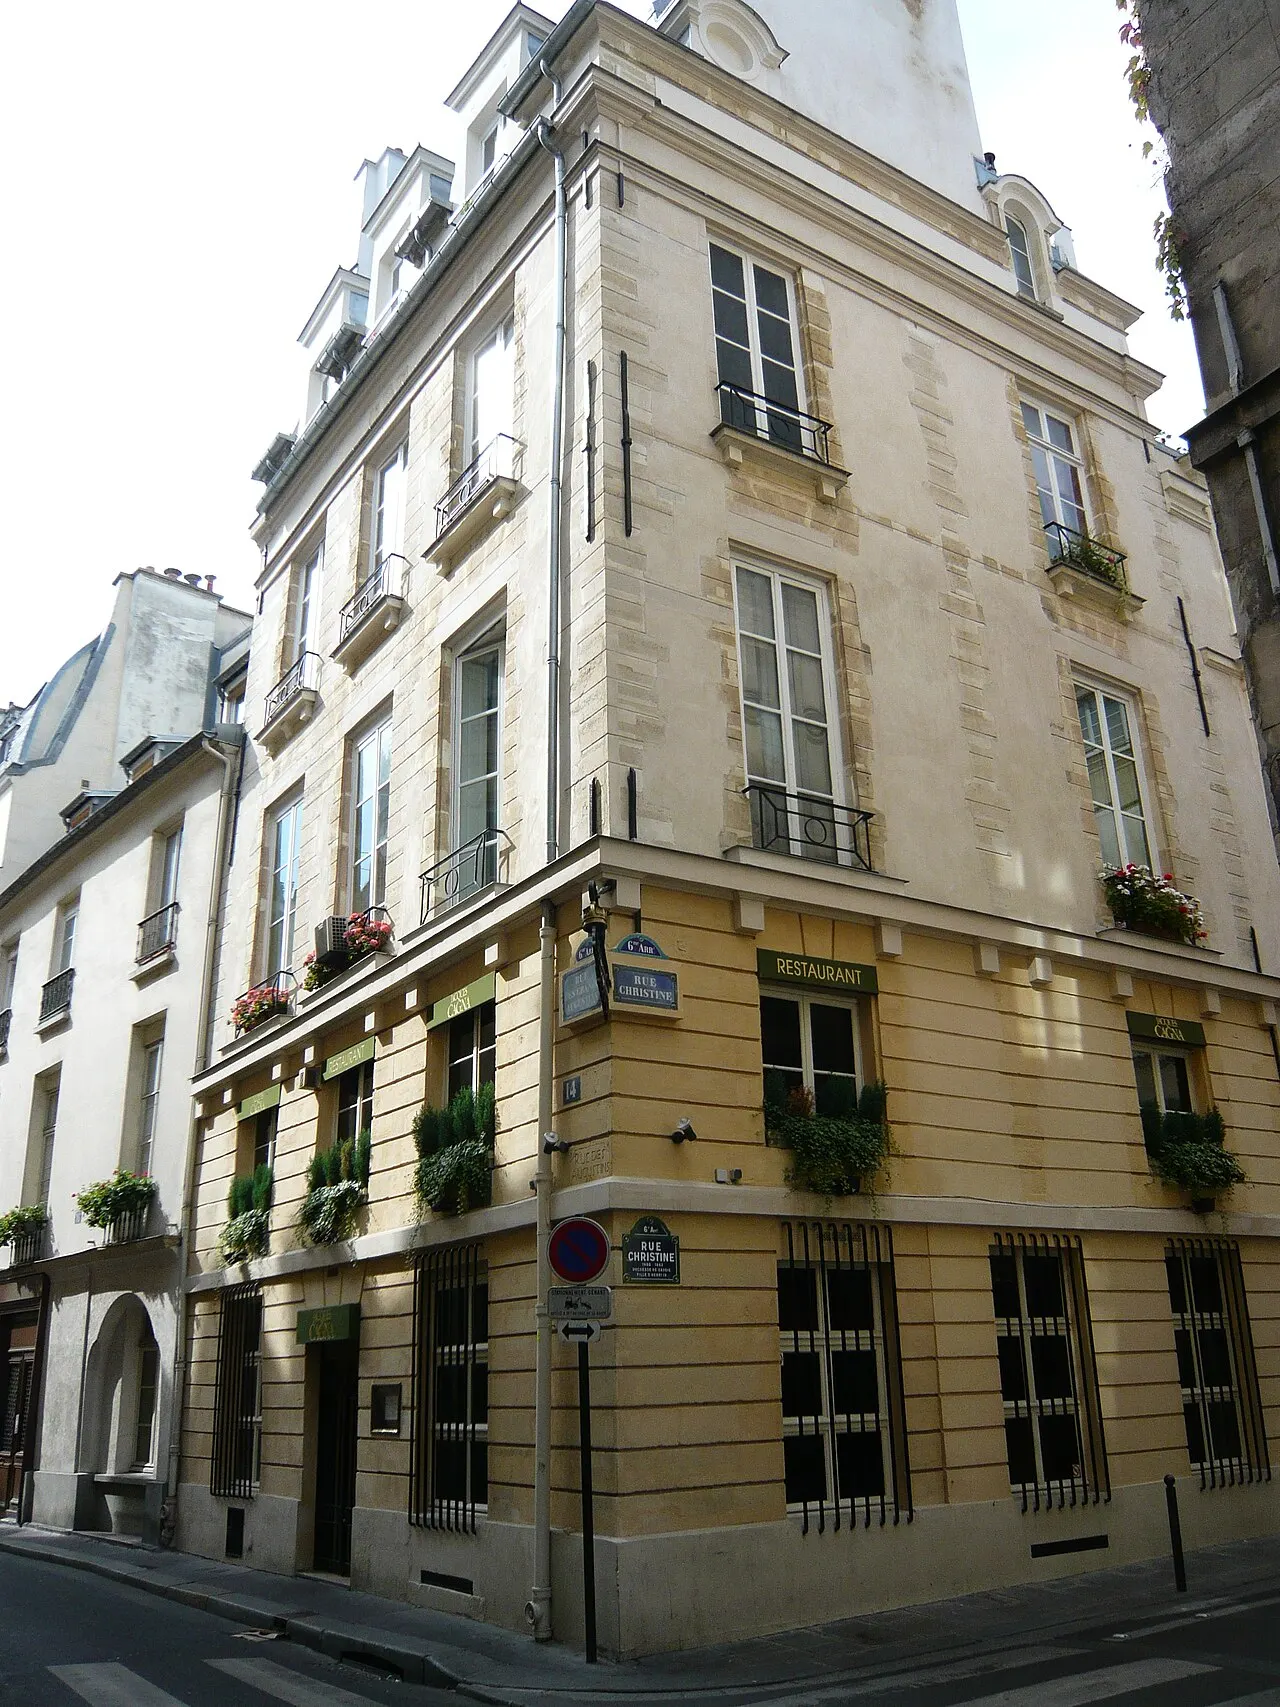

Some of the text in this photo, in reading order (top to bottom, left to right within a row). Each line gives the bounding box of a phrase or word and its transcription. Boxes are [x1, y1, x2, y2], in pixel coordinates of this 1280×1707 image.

[776, 958, 861, 985] RESTAURANT
[634, 975, 657, 988] RUE
[619, 985, 672, 1001] CHRISTINE
[447, 996, 471, 1018] CAGNA
[1154, 1024, 1185, 1041] CAGNA
[329, 1044, 365, 1073] RESTAURANT
[566, 1080, 577, 1099] 14
[641, 1241, 662, 1251] RUE
[628, 1252, 675, 1263] CHRISTINE
